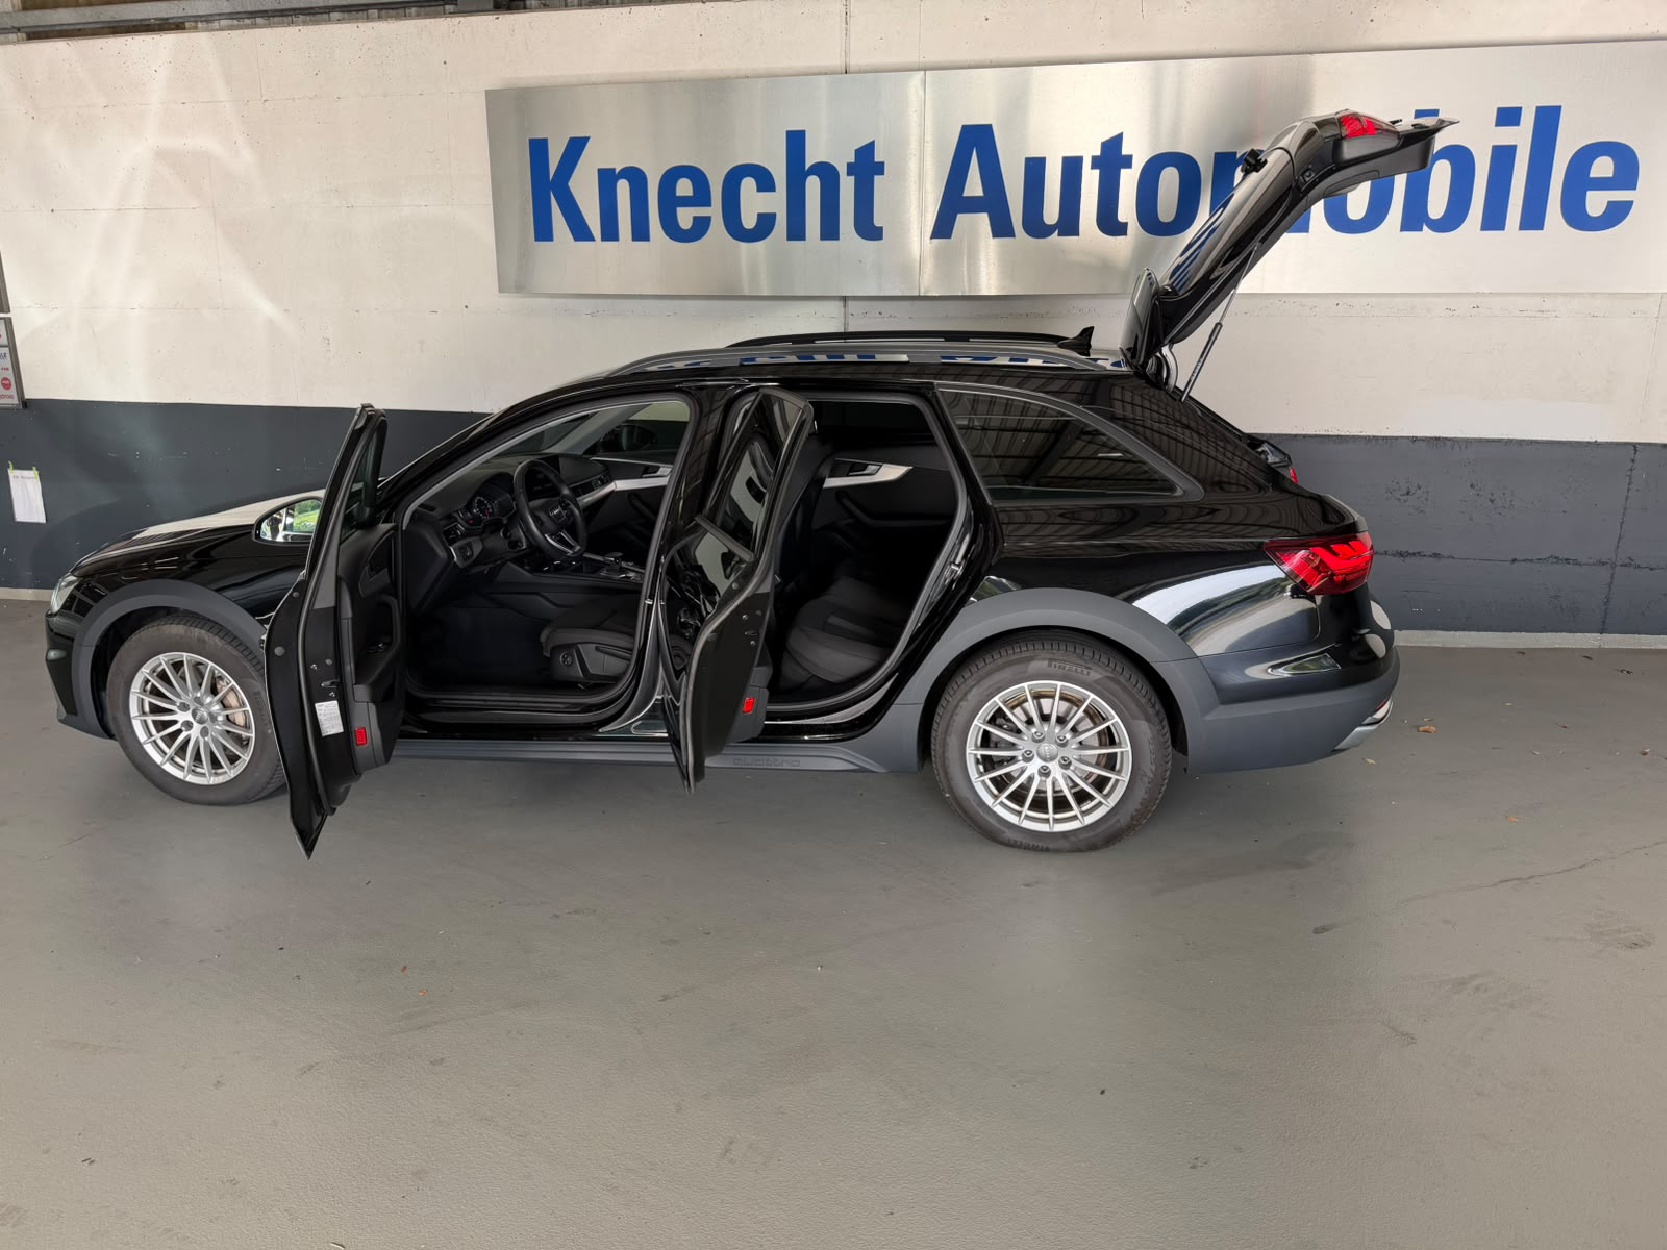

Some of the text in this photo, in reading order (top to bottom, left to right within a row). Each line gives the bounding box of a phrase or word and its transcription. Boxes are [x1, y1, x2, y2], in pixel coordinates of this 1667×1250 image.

[528, 105, 1640, 243] Knecht Autoobile
[732, 757, 801, 768] quattro
